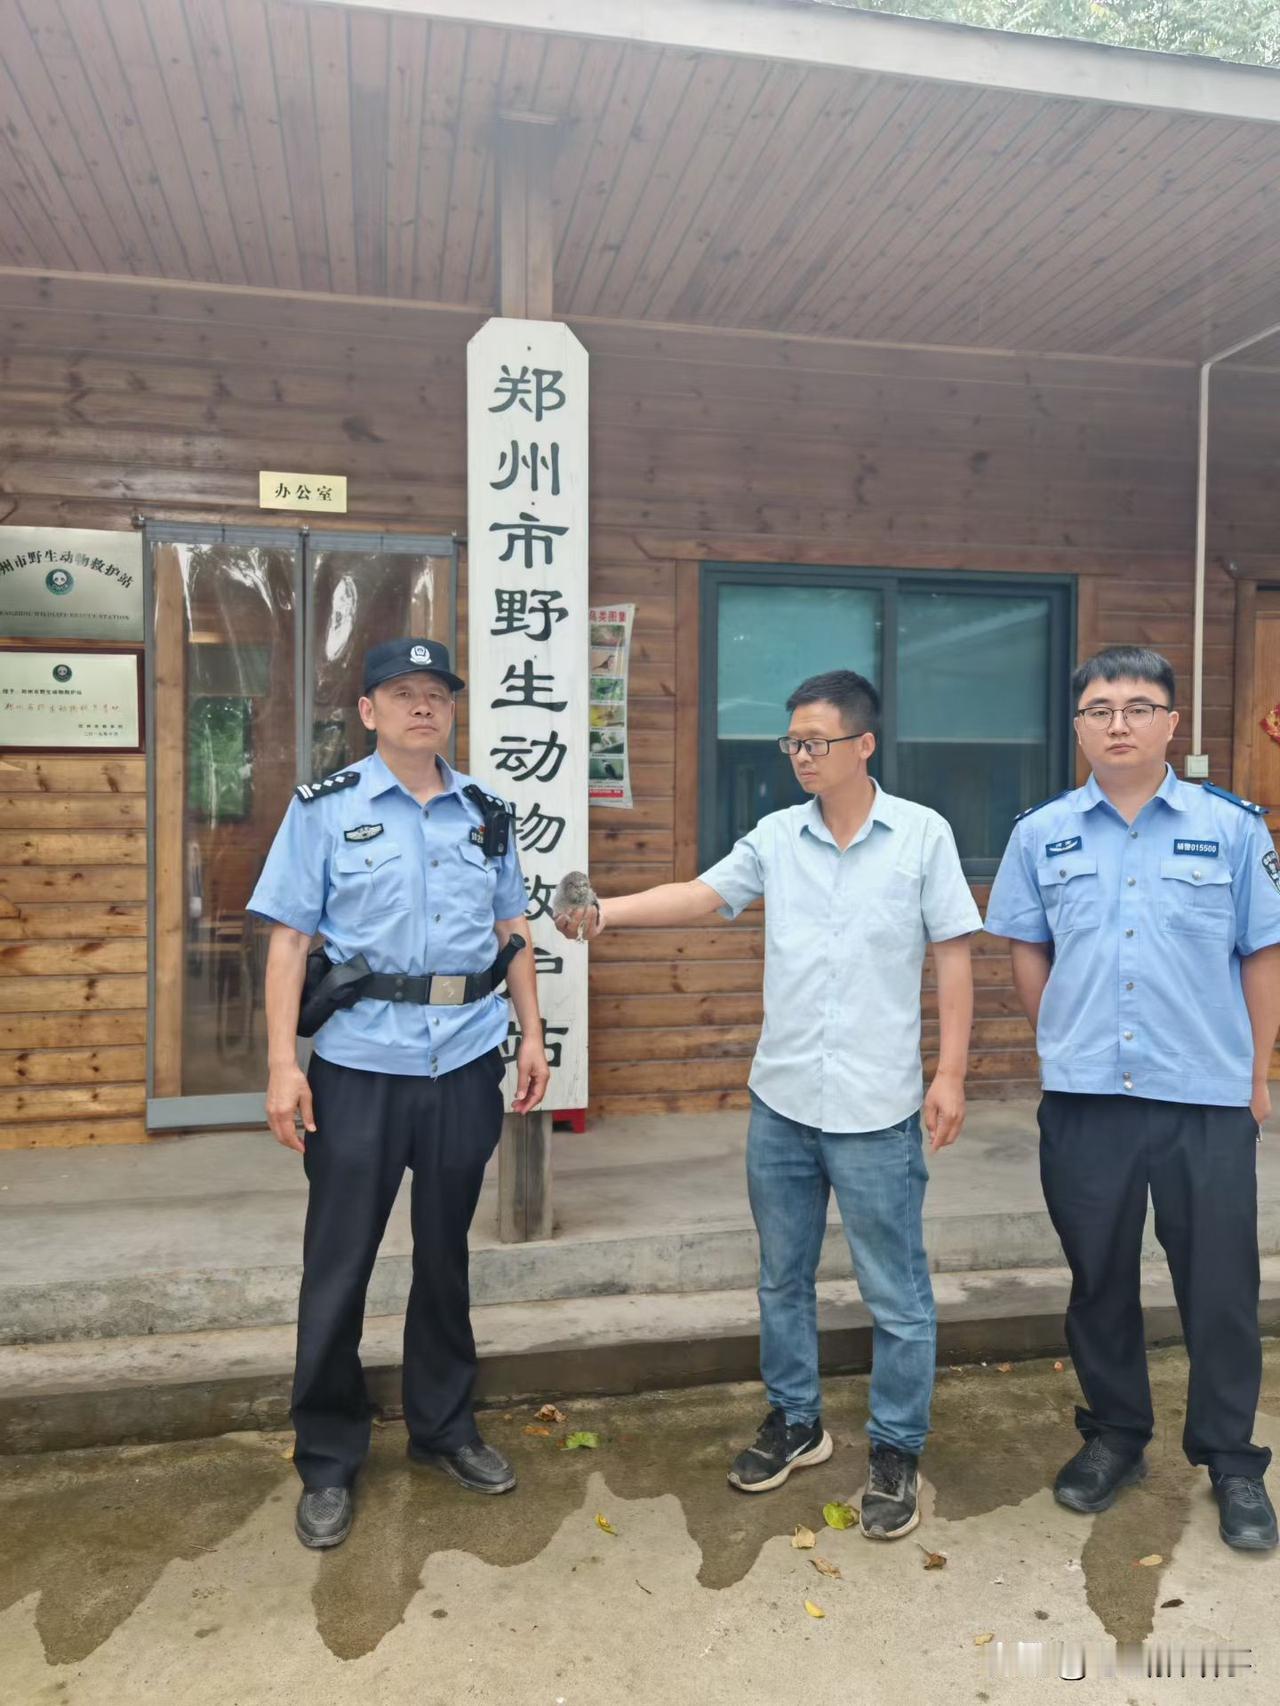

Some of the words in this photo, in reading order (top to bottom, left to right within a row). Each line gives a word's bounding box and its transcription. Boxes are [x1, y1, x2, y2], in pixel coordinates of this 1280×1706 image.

[275, 482, 332, 501] 办公室
[0, 549, 134, 589] 州市野生动物救护站
